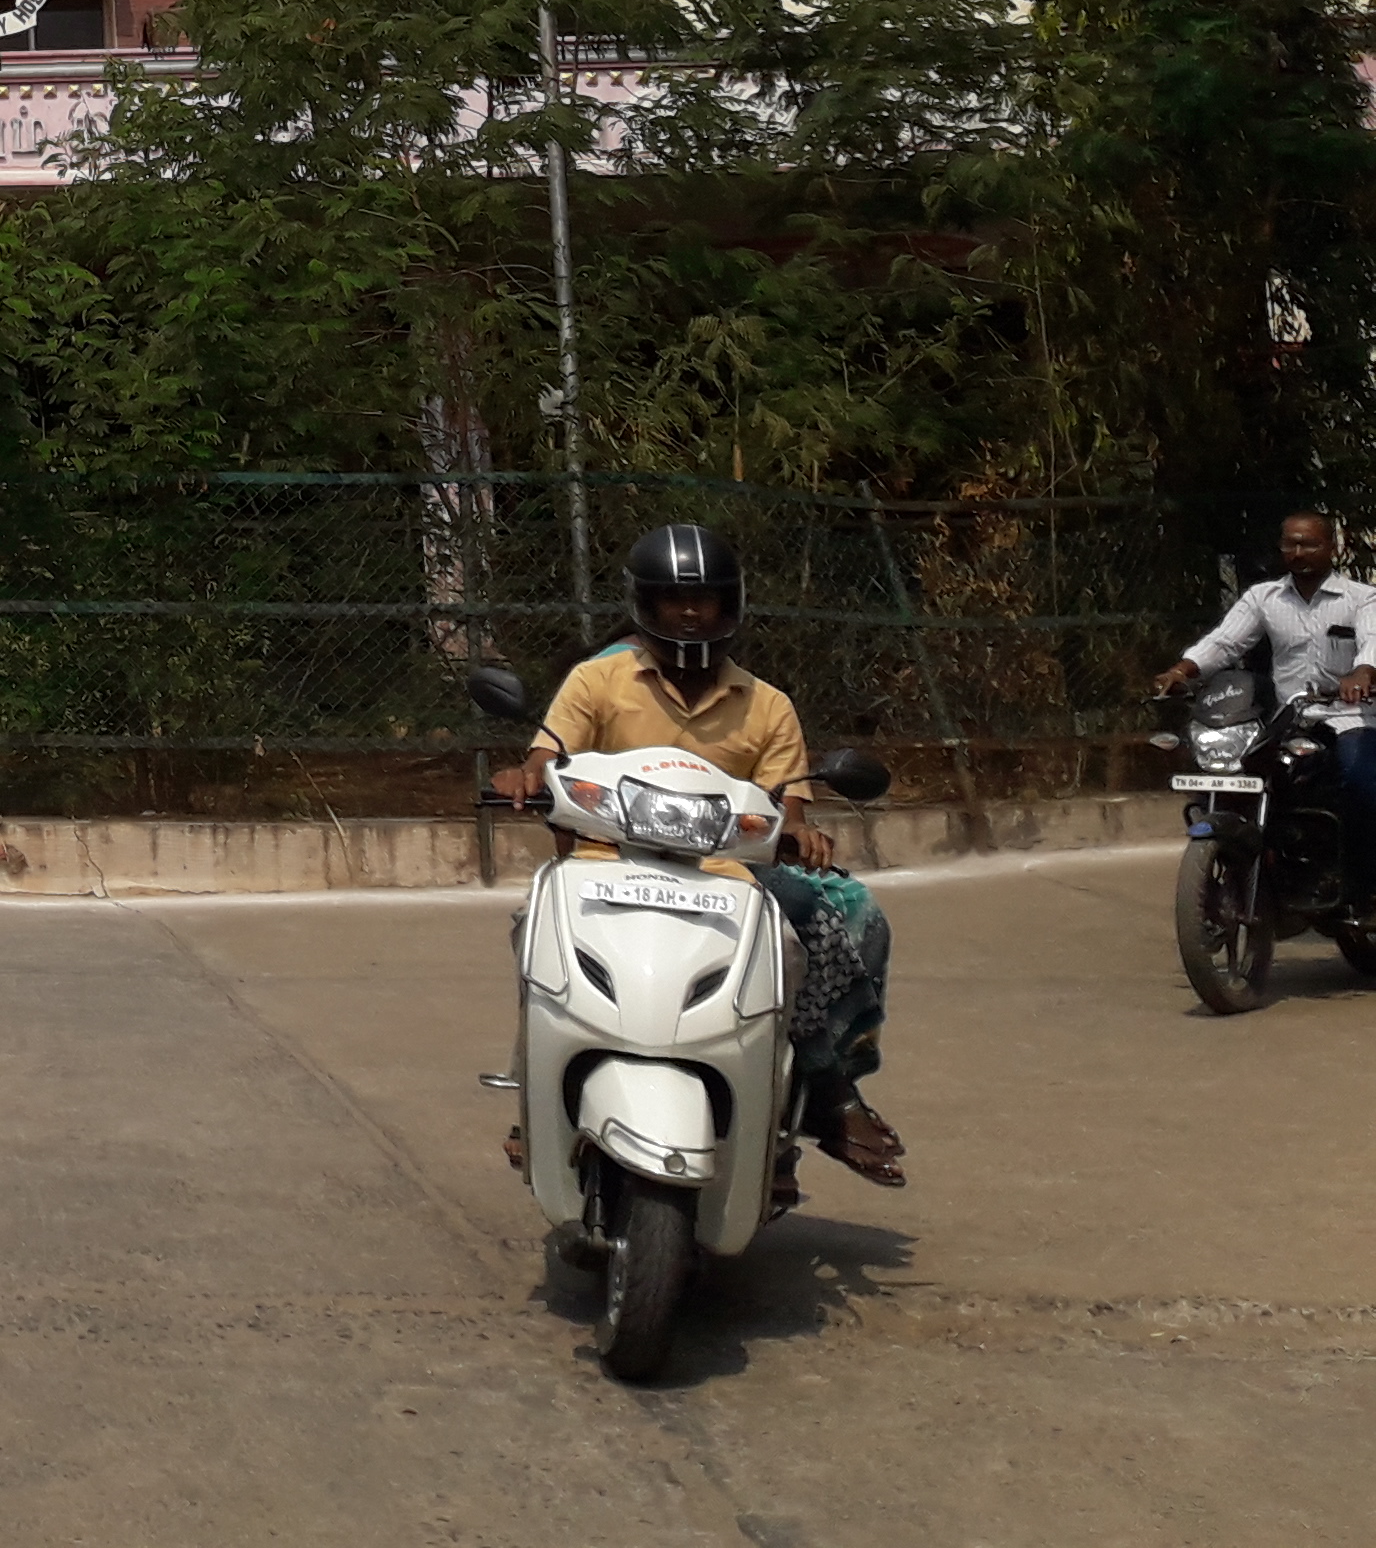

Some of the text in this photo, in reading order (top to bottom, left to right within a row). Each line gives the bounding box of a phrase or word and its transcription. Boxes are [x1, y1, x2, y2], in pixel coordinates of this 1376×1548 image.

[625, 873, 683, 885] HONDA
[594, 882, 729, 912] TN 18 AH 4673
